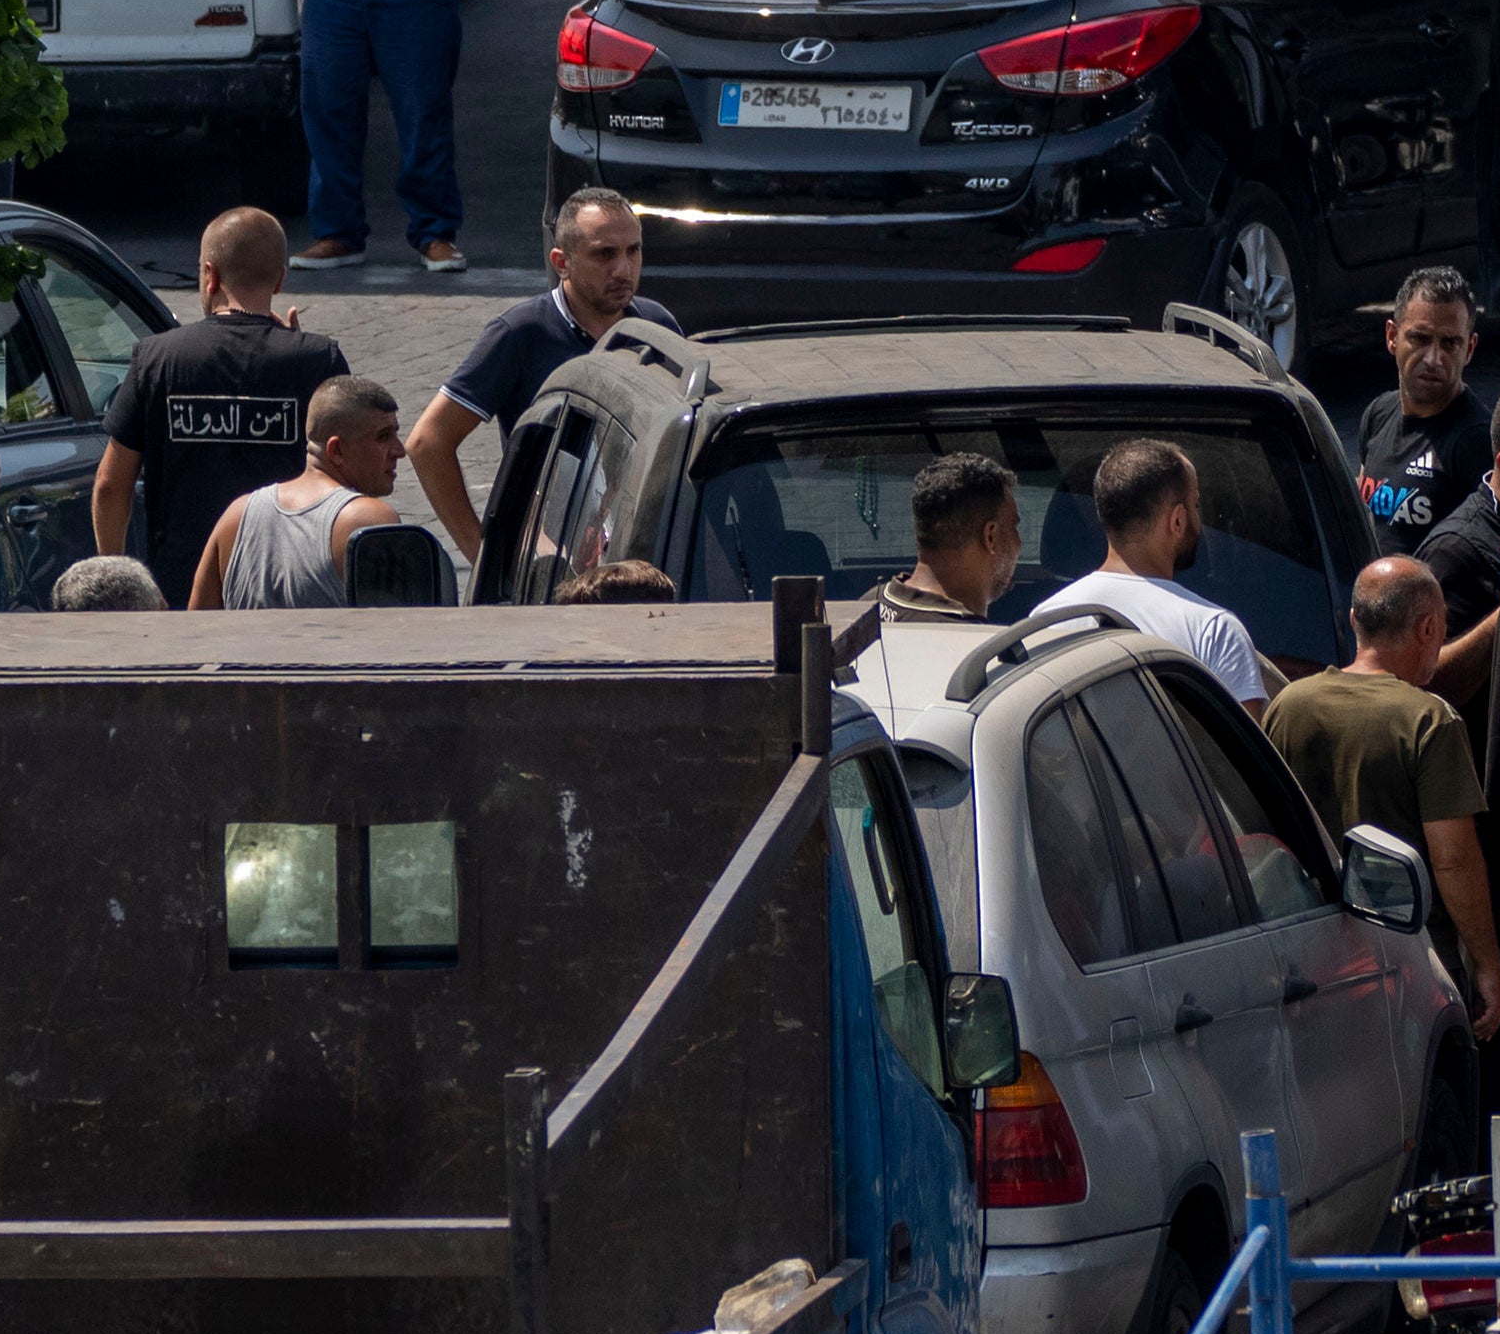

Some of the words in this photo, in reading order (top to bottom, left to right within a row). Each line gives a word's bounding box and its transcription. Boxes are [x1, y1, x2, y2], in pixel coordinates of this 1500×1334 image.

[609, 114, 665, 130] HYUNDAI
[951, 120, 1033, 137] Tucson
[964, 177, 1010, 190] 4WD
[173, 404, 240, 435] الدولة
[250, 402, 291, 439] أمن
[1406, 468, 1433, 478] adidas
